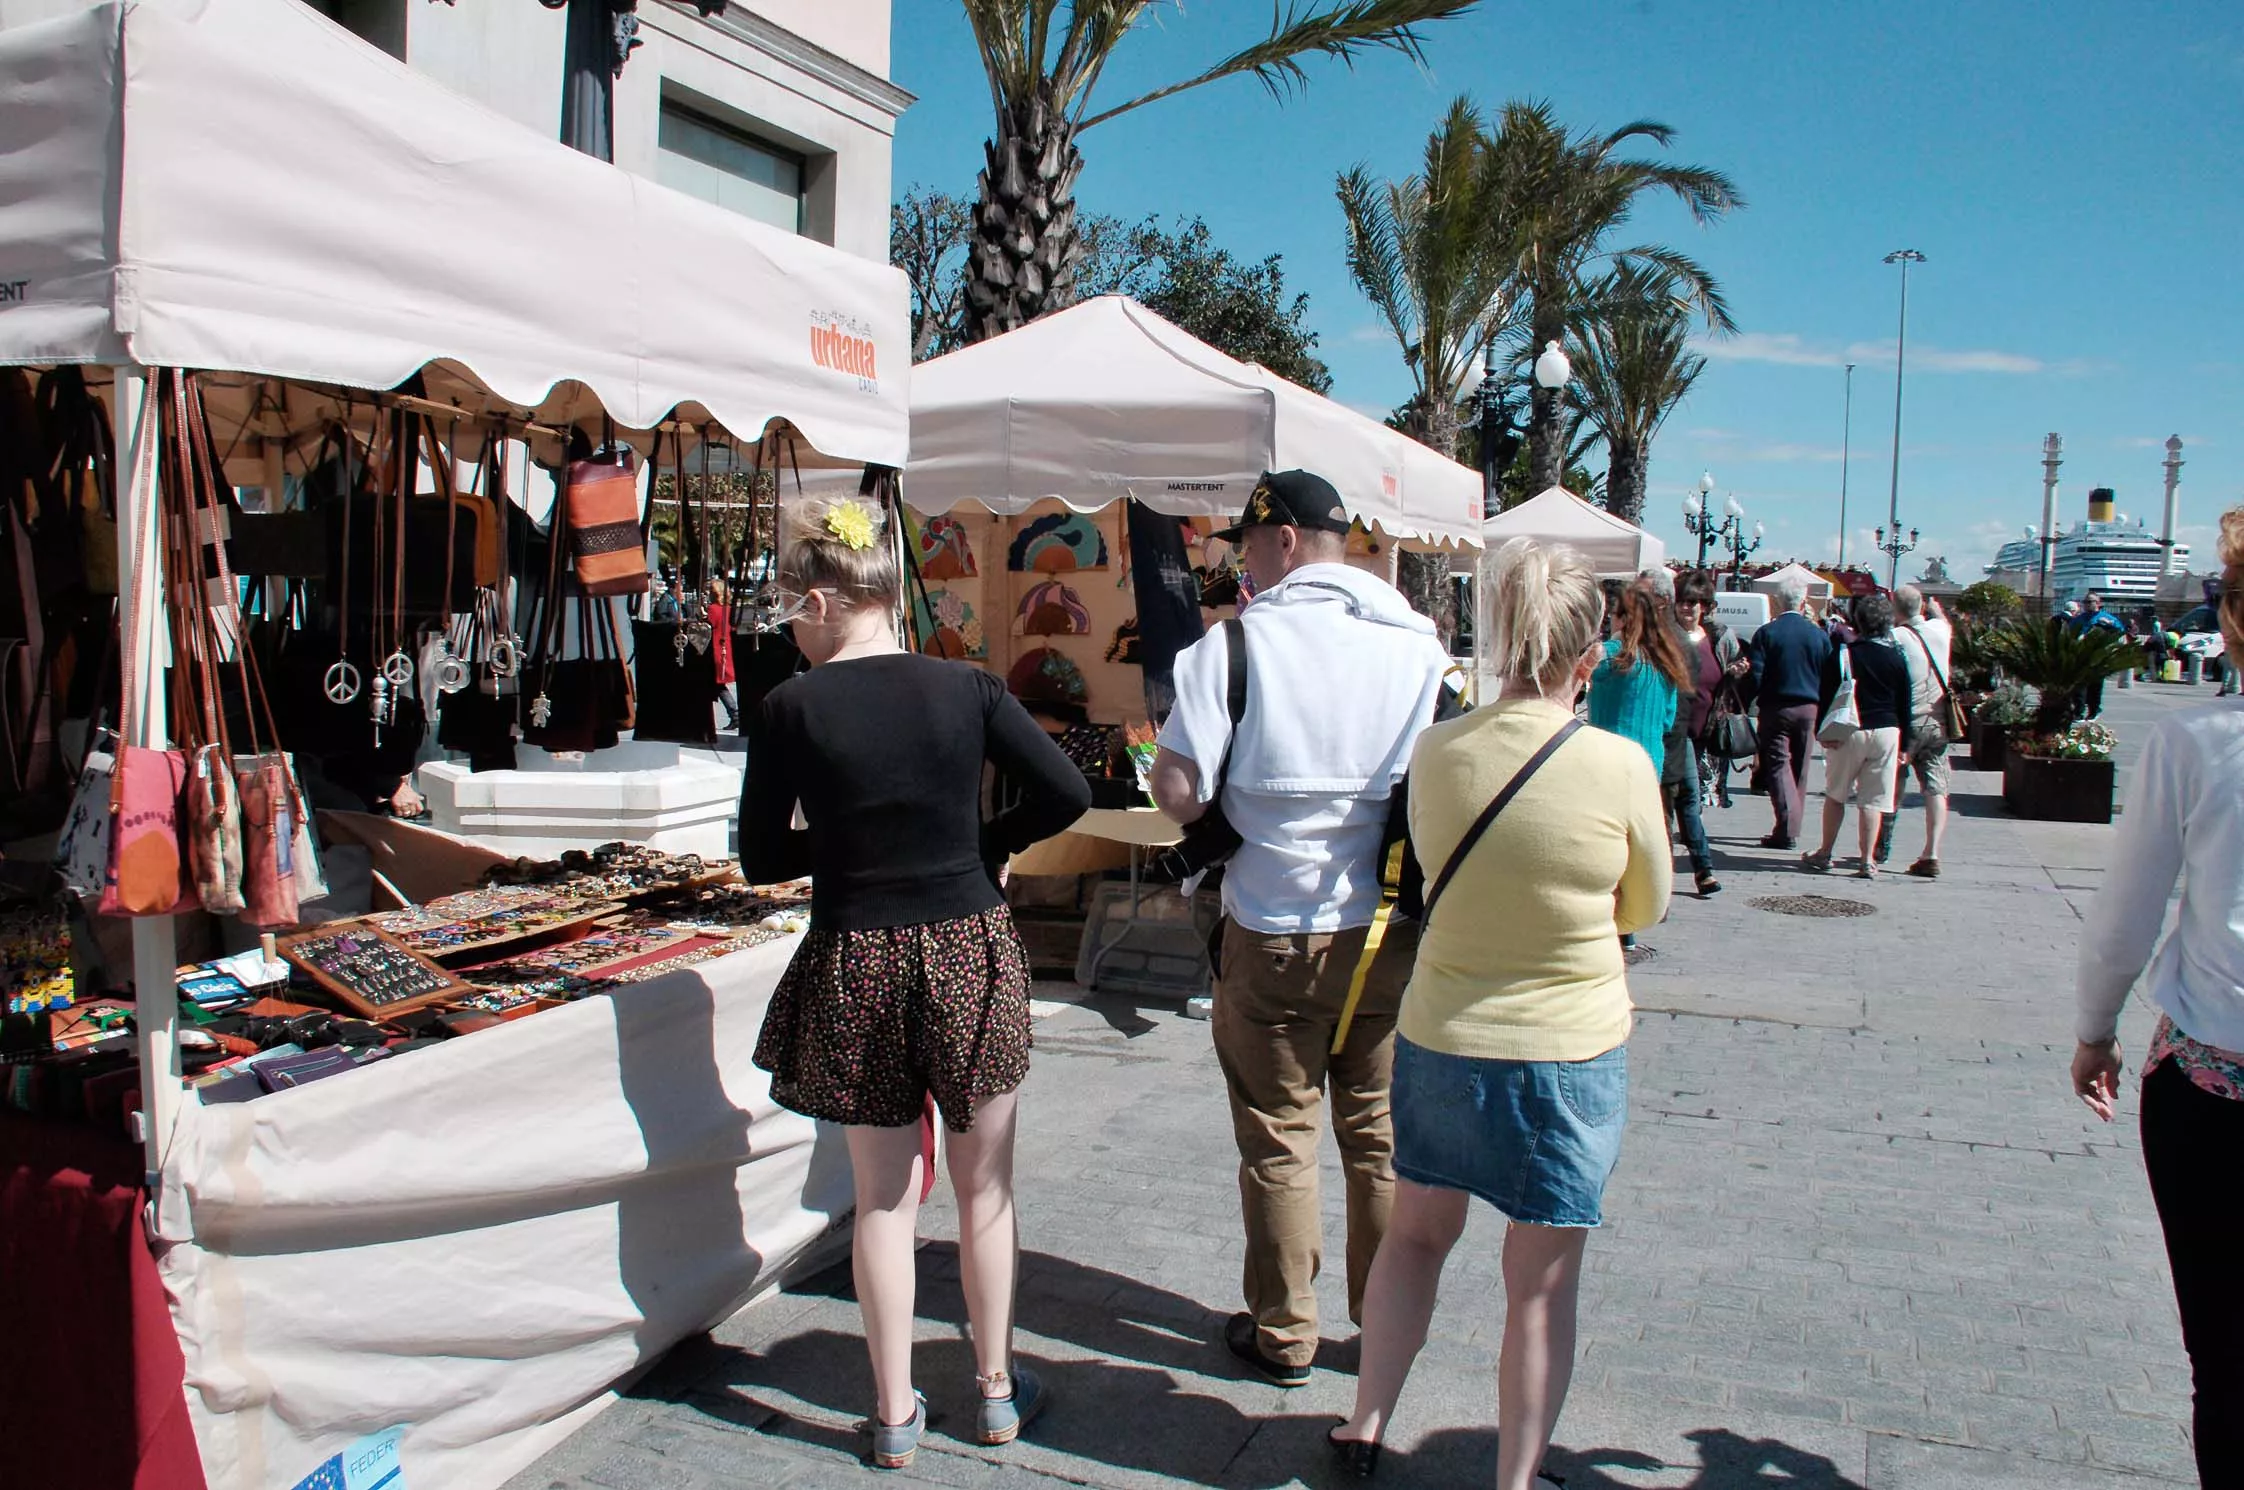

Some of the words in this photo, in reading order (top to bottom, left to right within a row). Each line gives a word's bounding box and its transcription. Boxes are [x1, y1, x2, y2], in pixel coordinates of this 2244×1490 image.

[810, 323, 876, 380] urbana
[1167, 483, 1225, 491] MASTERTENT
[350, 1438, 396, 1479] FEDER
